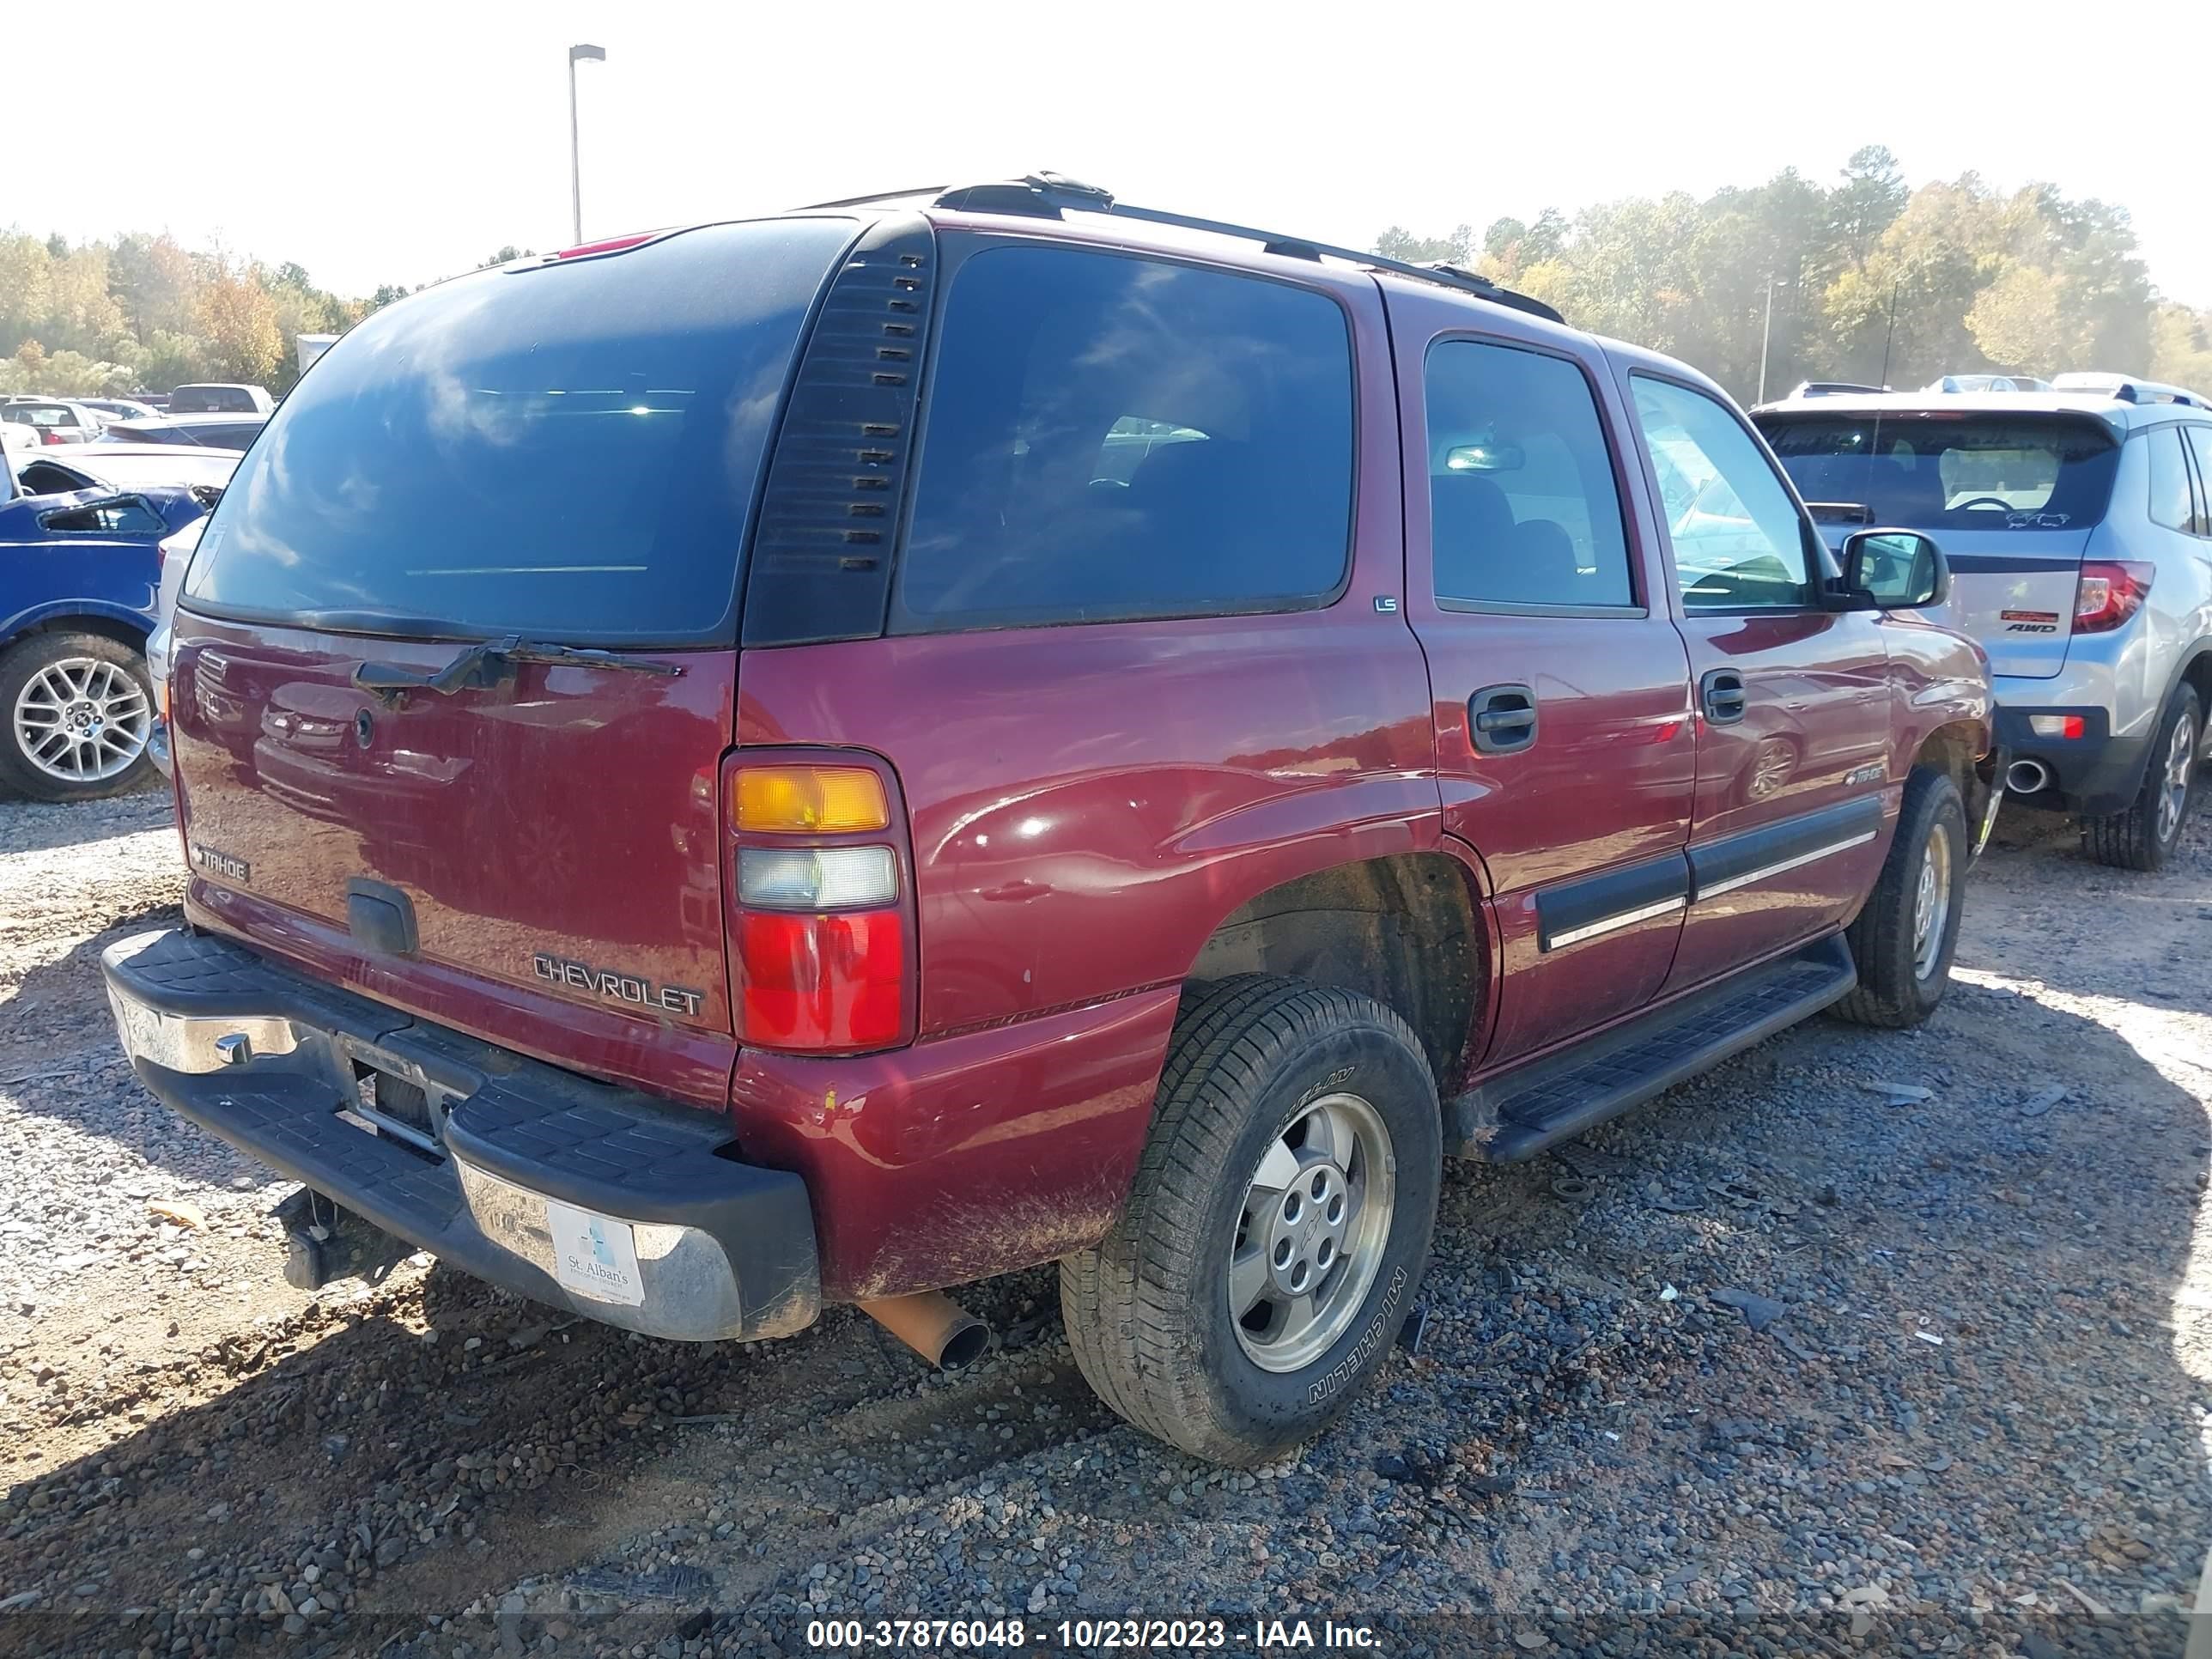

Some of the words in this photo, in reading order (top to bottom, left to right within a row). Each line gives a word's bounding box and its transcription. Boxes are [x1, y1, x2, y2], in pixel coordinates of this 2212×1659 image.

[1375, 599, 1396, 611] LS
[2005, 623, 2057, 633] AWD
[204, 850, 246, 881] TAHOE
[533, 955, 702, 1016] CHEVROLET
[586, 1262, 629, 1285] Alban's
[1308, 1266, 1408, 1405] MICHELIN
